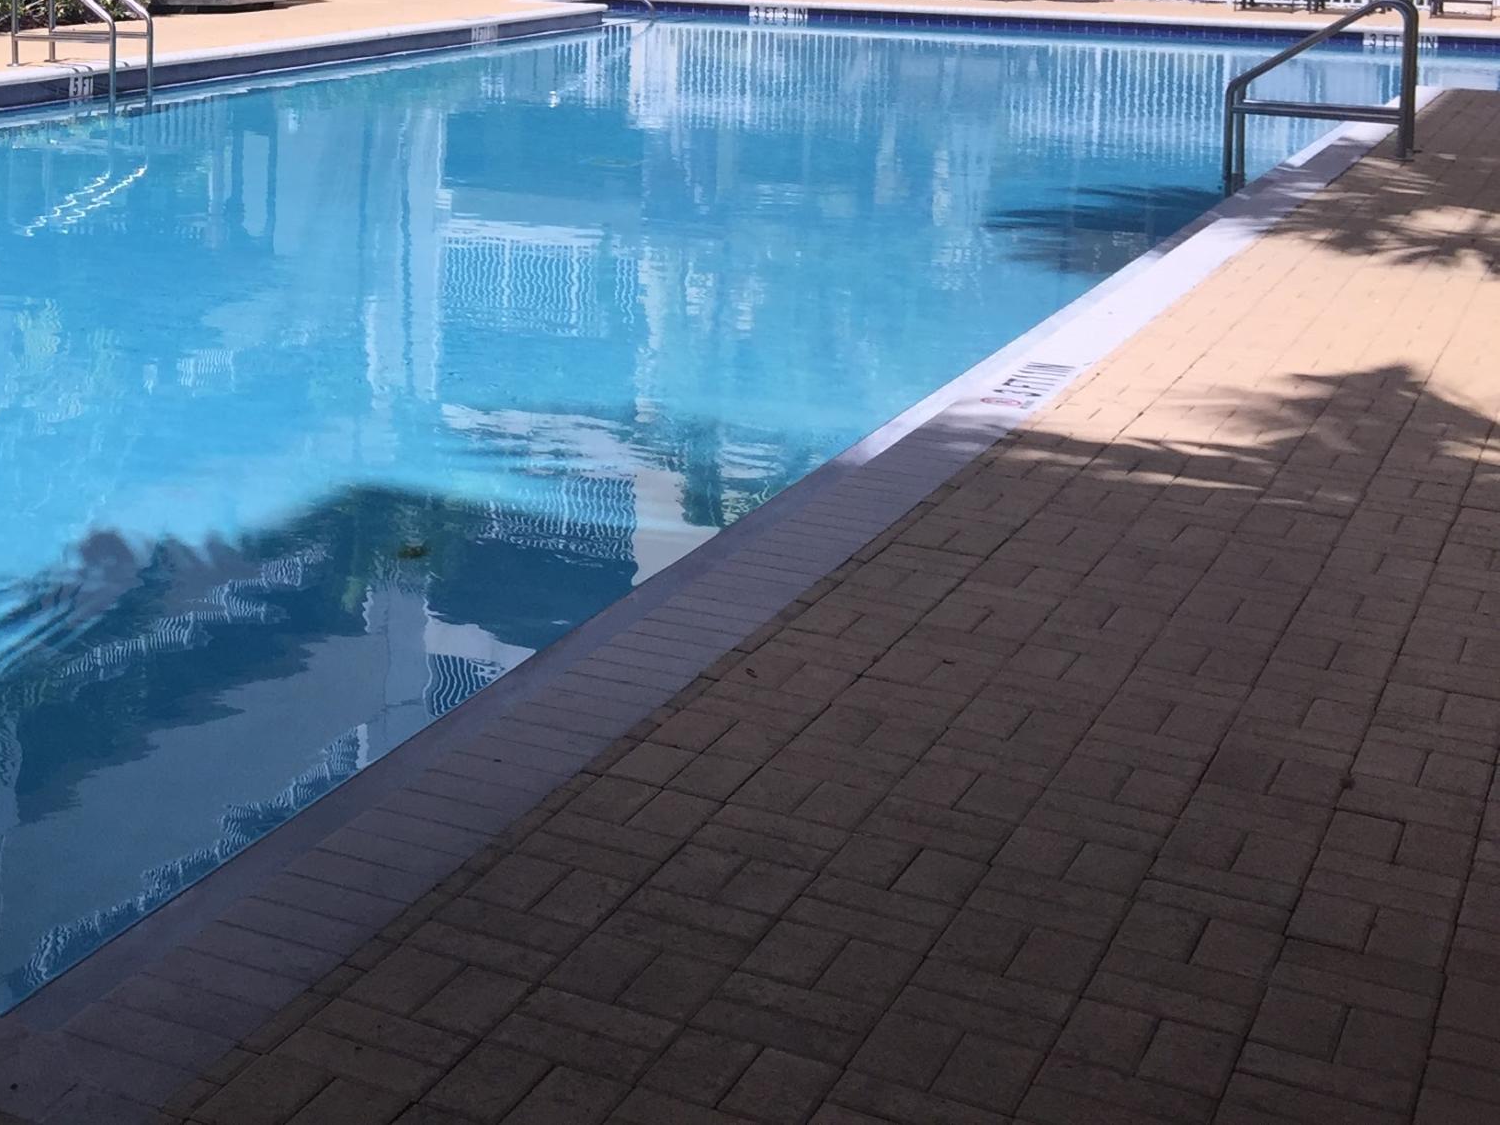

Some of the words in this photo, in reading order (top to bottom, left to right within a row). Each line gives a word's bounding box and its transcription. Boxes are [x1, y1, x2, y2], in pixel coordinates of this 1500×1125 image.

[754, 6, 759, 18] 3
[764, 7, 777, 18] FT
[782, 8, 788, 18] 3
[794, 8, 806, 19] IN
[1370, 34, 1376, 46] 3
[1383, 34, 1400, 47] FT
[1421, 36, 1435, 48] IN
[74, 76, 78, 95] 5
[82, 76, 92, 95] FT
